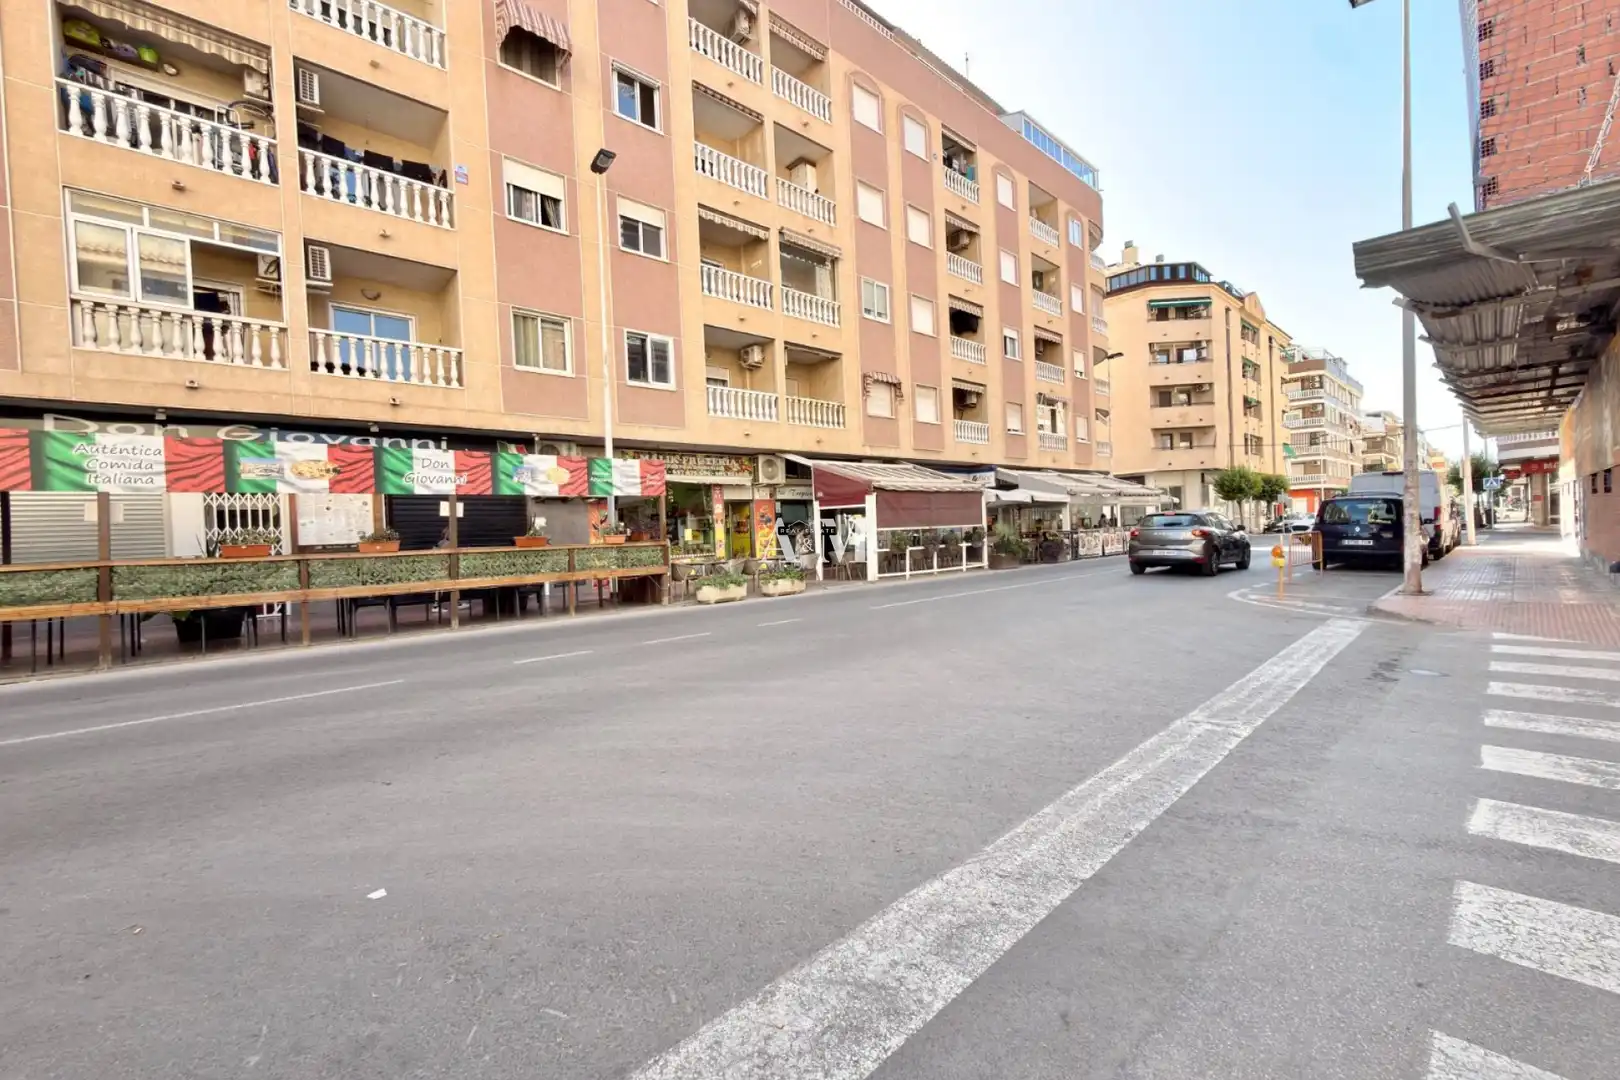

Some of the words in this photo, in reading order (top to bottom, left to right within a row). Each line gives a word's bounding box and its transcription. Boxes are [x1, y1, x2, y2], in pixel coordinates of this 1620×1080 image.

[43, 413, 189, 437] Don
[216, 424, 449, 451] Giovanni
[73, 443, 163, 456] Auténtica
[85, 458, 154, 470] Comida
[421, 457, 450, 469] Don
[87, 472, 155, 485] Italiana
[404, 471, 468, 485] Giovanni
